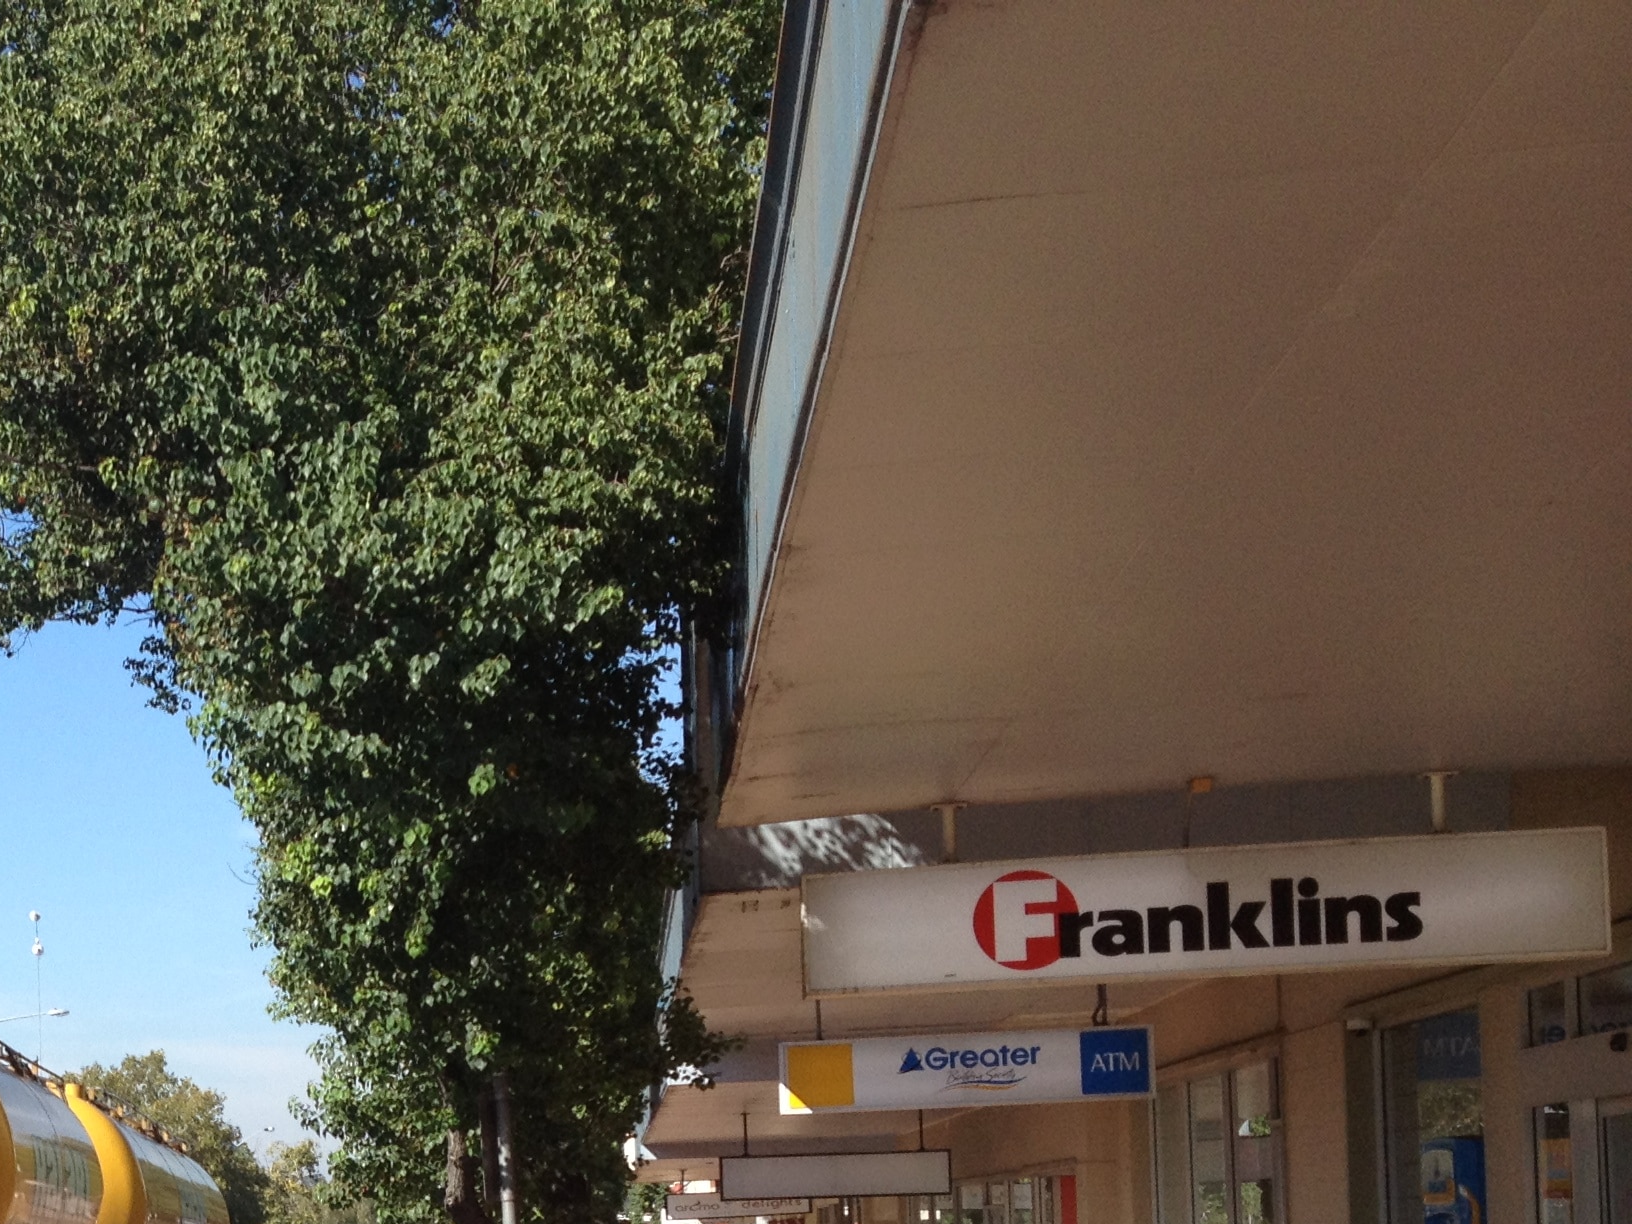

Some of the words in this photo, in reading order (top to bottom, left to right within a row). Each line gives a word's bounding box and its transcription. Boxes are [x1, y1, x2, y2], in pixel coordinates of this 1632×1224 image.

[993, 876, 1424, 962] Franklins
[925, 1045, 1041, 1070] Greater
[1090, 1052, 1140, 1072] ATM
